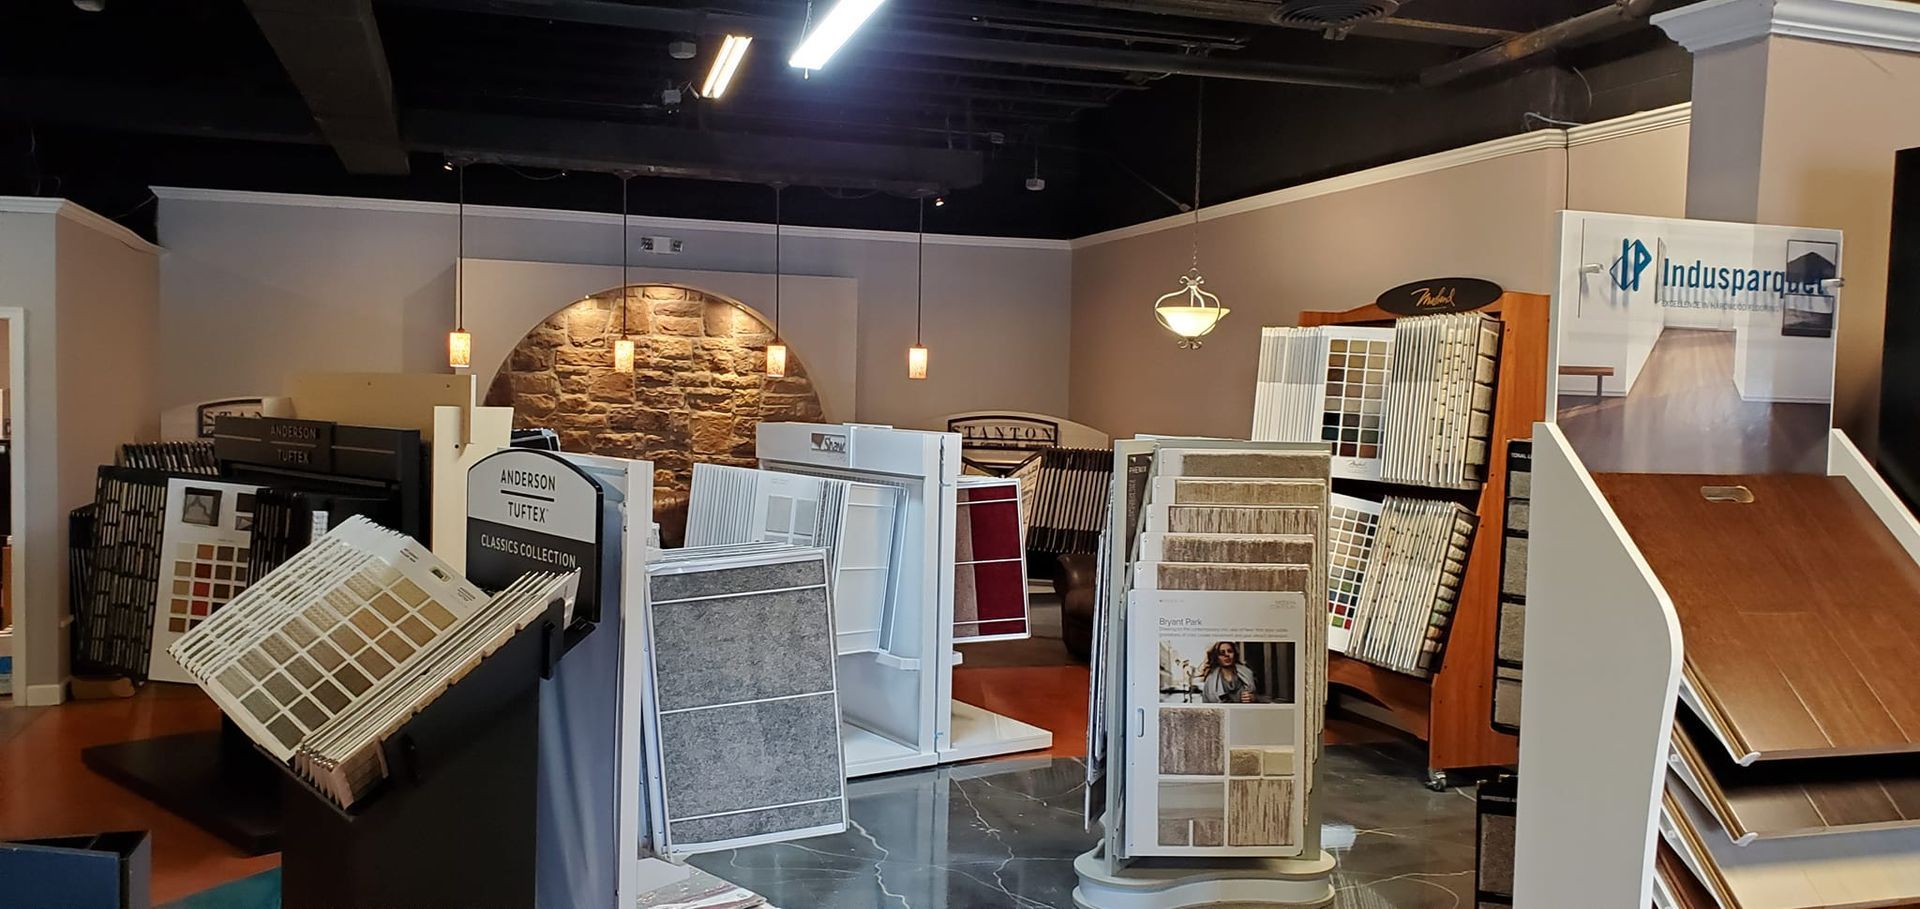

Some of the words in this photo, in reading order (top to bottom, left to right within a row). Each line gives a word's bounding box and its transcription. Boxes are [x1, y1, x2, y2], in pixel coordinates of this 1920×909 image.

[1662, 257, 1825, 299] Indusparquet
[270, 424, 316, 440] ANDERSON
[951, 424, 1053, 440] STANTON
[824, 436, 846, 452] Shaw
[277, 448, 309, 464] TUFTEX
[500, 469, 556, 492] ANDERSON
[508, 501, 546, 524] TUFTEX
[481, 533, 519, 555] CLASSICS
[520, 543, 577, 569] COLLECTION
[1159, 617, 1184, 627] Bryant
[1185, 617, 1202, 626] Park
